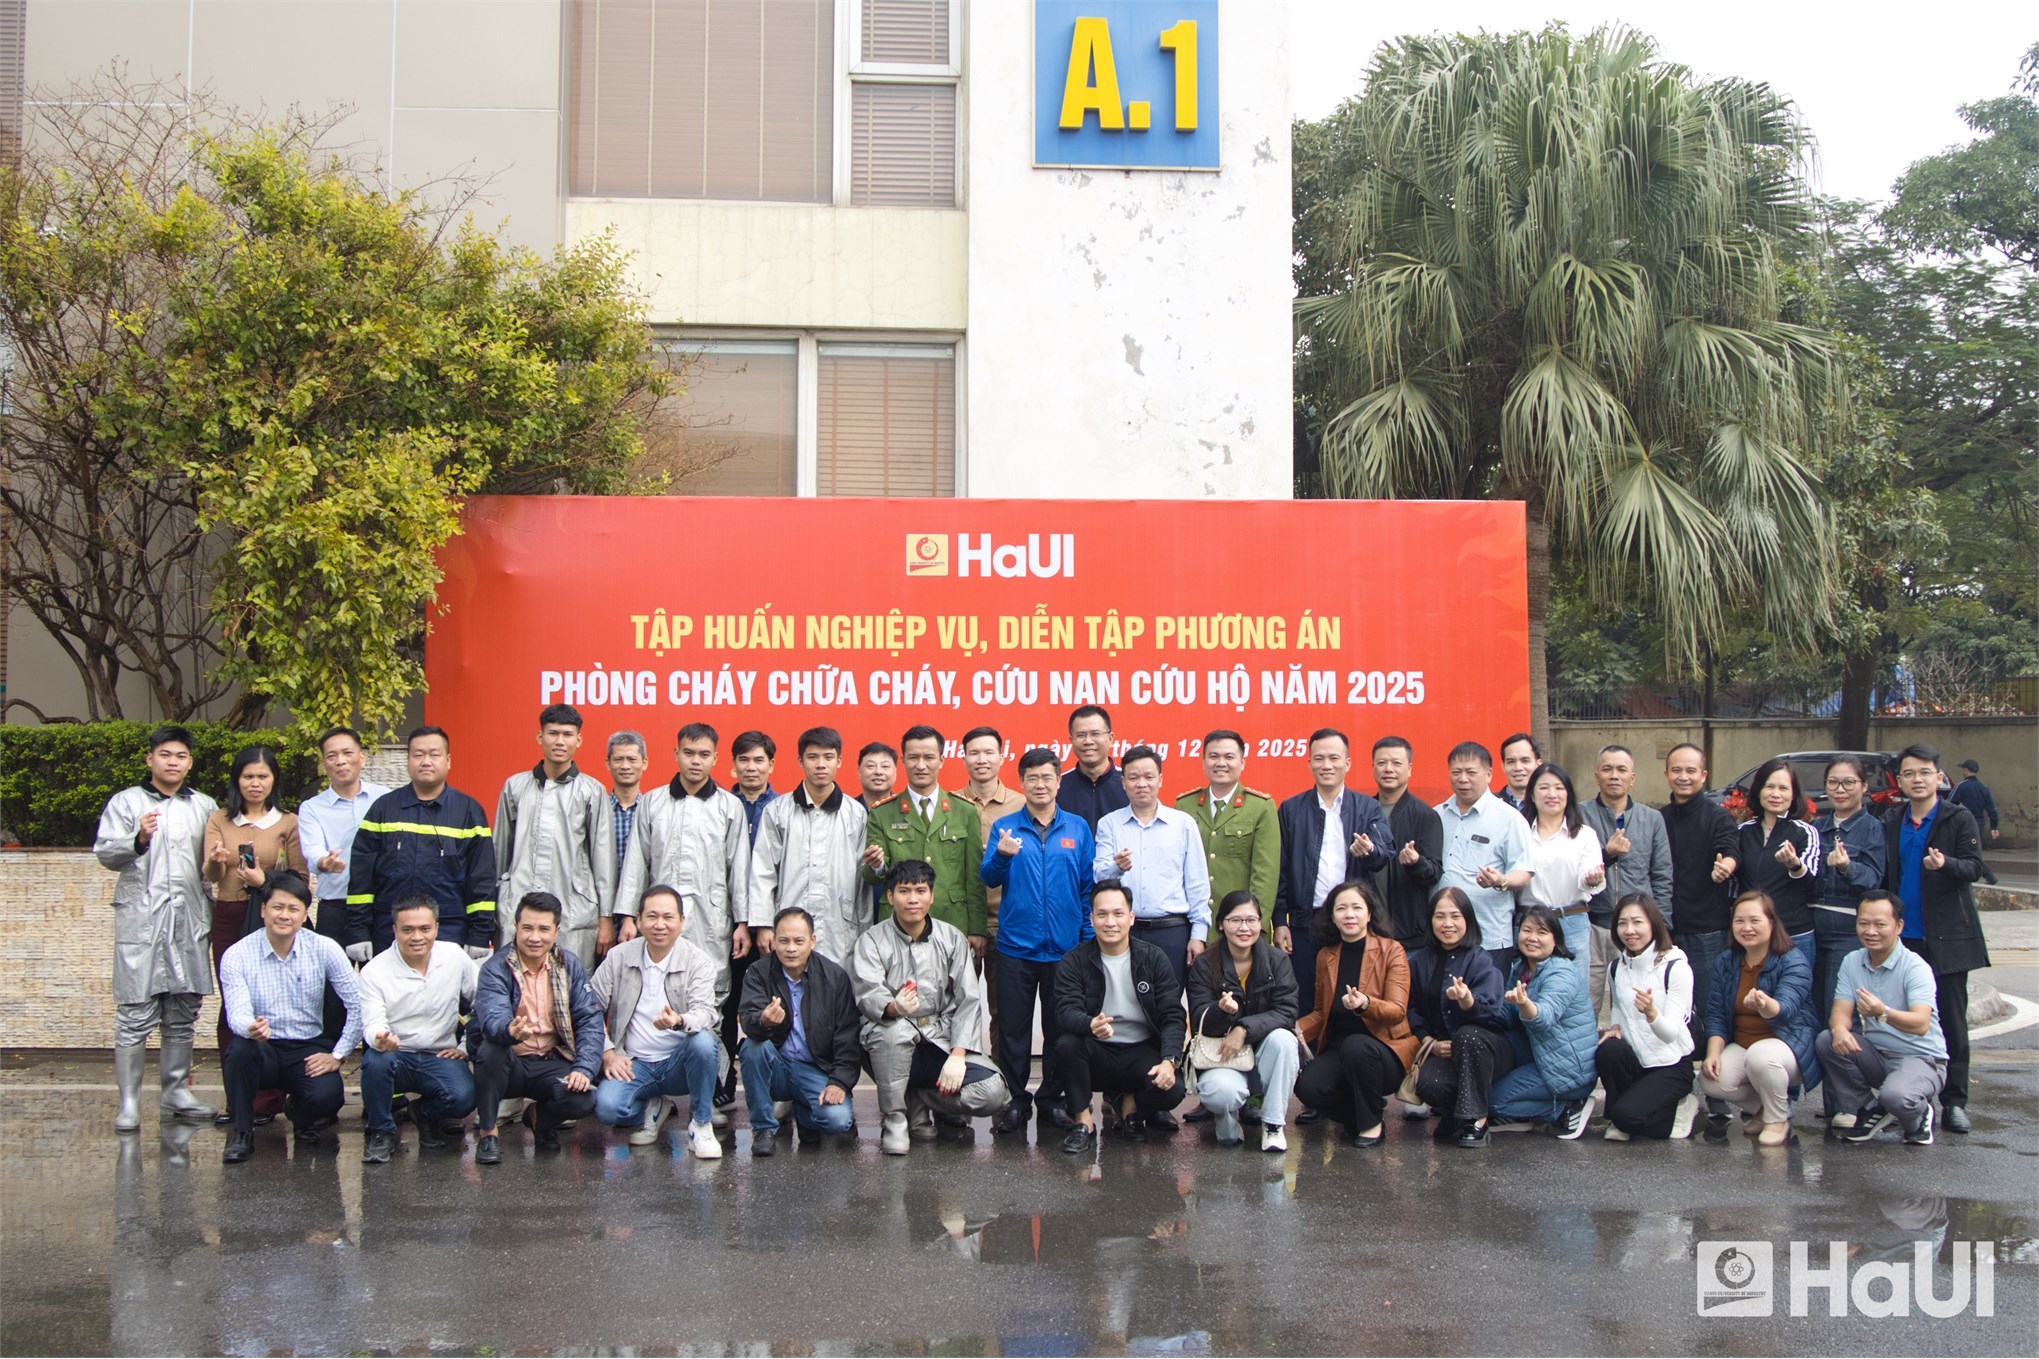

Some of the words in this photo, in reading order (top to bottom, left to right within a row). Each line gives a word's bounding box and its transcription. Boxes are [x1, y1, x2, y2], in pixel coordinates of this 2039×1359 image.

[1059, 17, 1197, 132] A.1
[958, 533, 1074, 578] HaUI
[631, 608, 693, 657] TẬP
[705, 603, 794, 649] HUẤN
[806, 608, 926, 657] NGHIỆP
[937, 615, 987, 656] VỤ,
[999, 604, 1073, 649] DIỄN
[1084, 609, 1145, 657] TẬP
[1156, 612, 1286, 649] PHƯƠNG
[1297, 609, 1340, 649] ÁN
[541, 663, 656, 705] PHÒNG
[669, 664, 757, 705] CHÁY
[768, 664, 858, 705] CHỮA
[870, 664, 960, 709] CHÁY,
[973, 664, 1038, 705] CỨU
[1050, 671, 1119, 704] NAN
[1131, 664, 1196, 704] CỨU
[1208, 664, 1250, 712] HỘ
[1262, 664, 1336, 704] NĂM
[1348, 671, 1424, 704] 2025
[1178, 739, 1201, 757] 12
[1257, 739, 1307, 757] 2025
